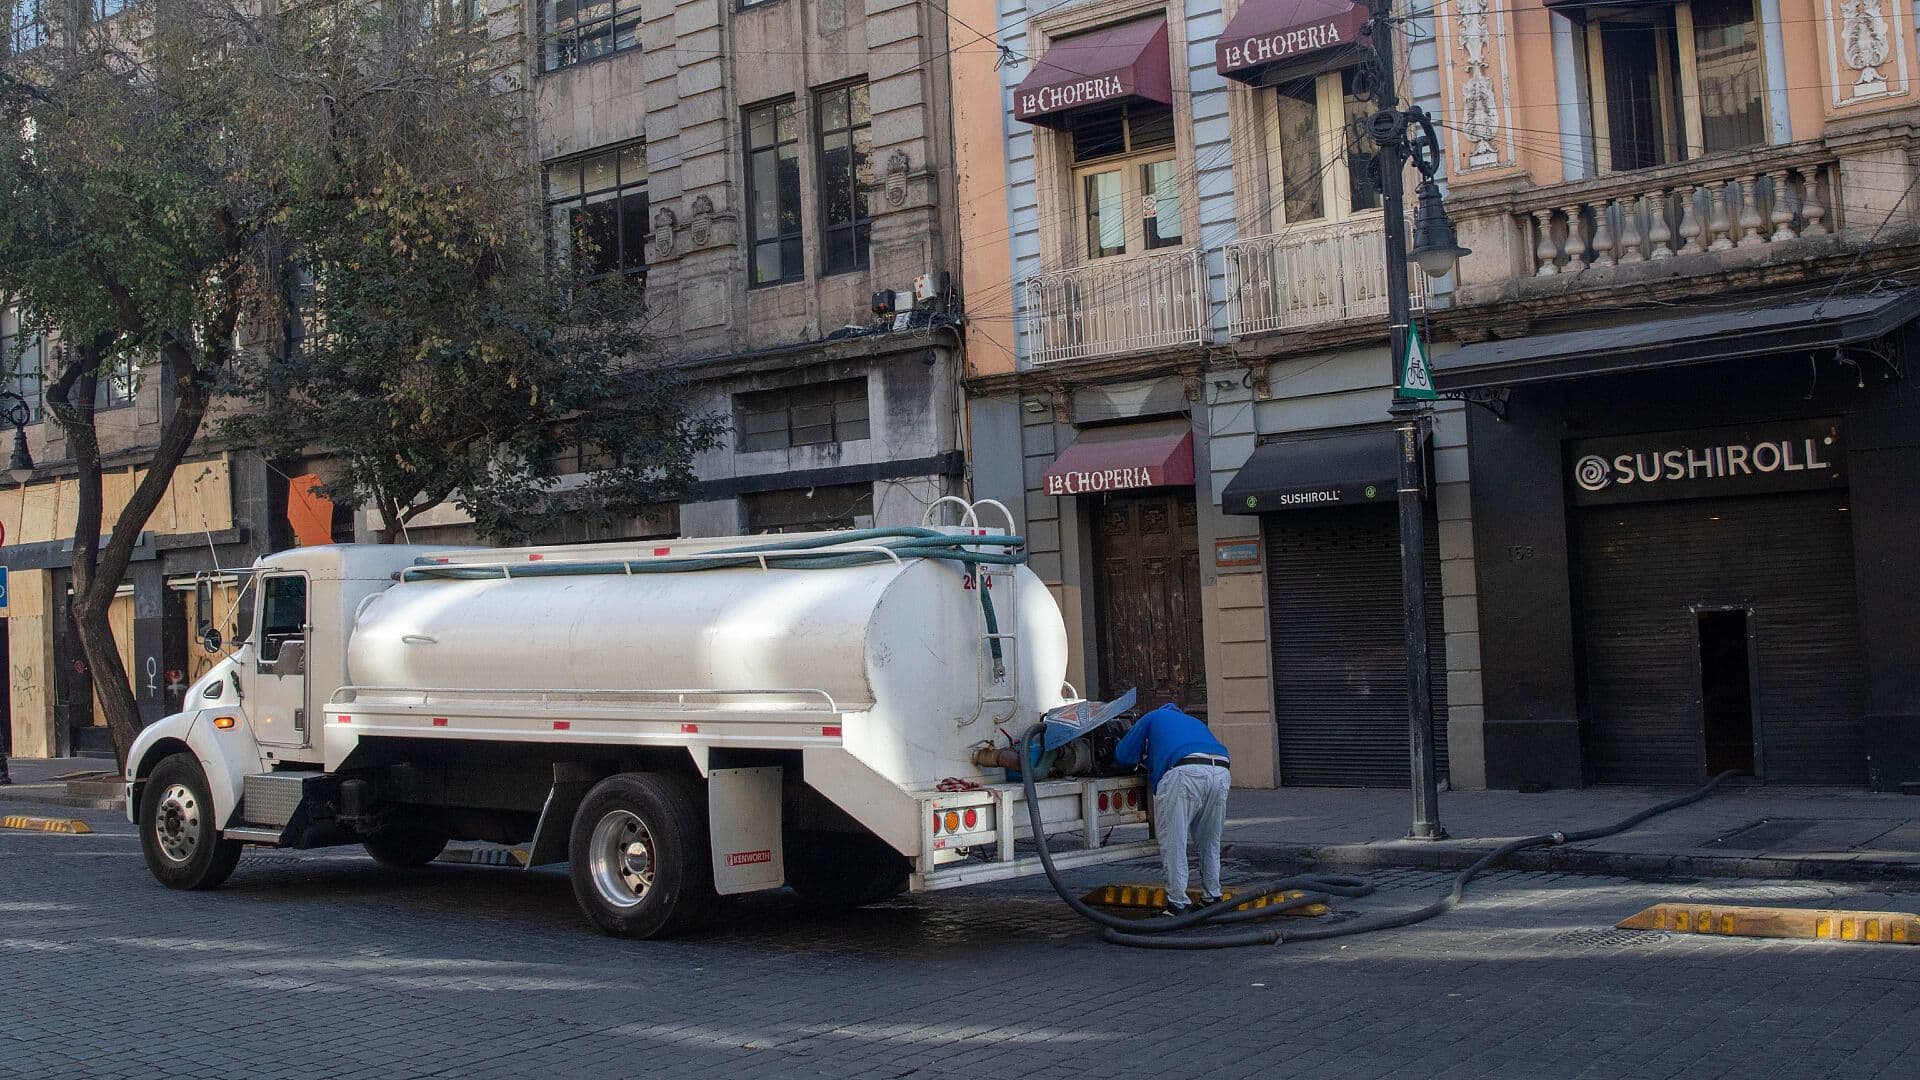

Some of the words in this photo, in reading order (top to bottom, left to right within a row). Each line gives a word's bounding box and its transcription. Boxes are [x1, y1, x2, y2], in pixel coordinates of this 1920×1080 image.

[1243, 22, 1341, 64] CHOPERIA
[1038, 75, 1123, 112] CHOPERIA
[1613, 438, 1829, 485] SUSHIROLL
[1064, 467, 1153, 494] CHOPERIA
[1280, 490, 1340, 505] SUSHIROLL
[963, 575, 993, 590] 204
[733, 851, 770, 864] KENWORTH
